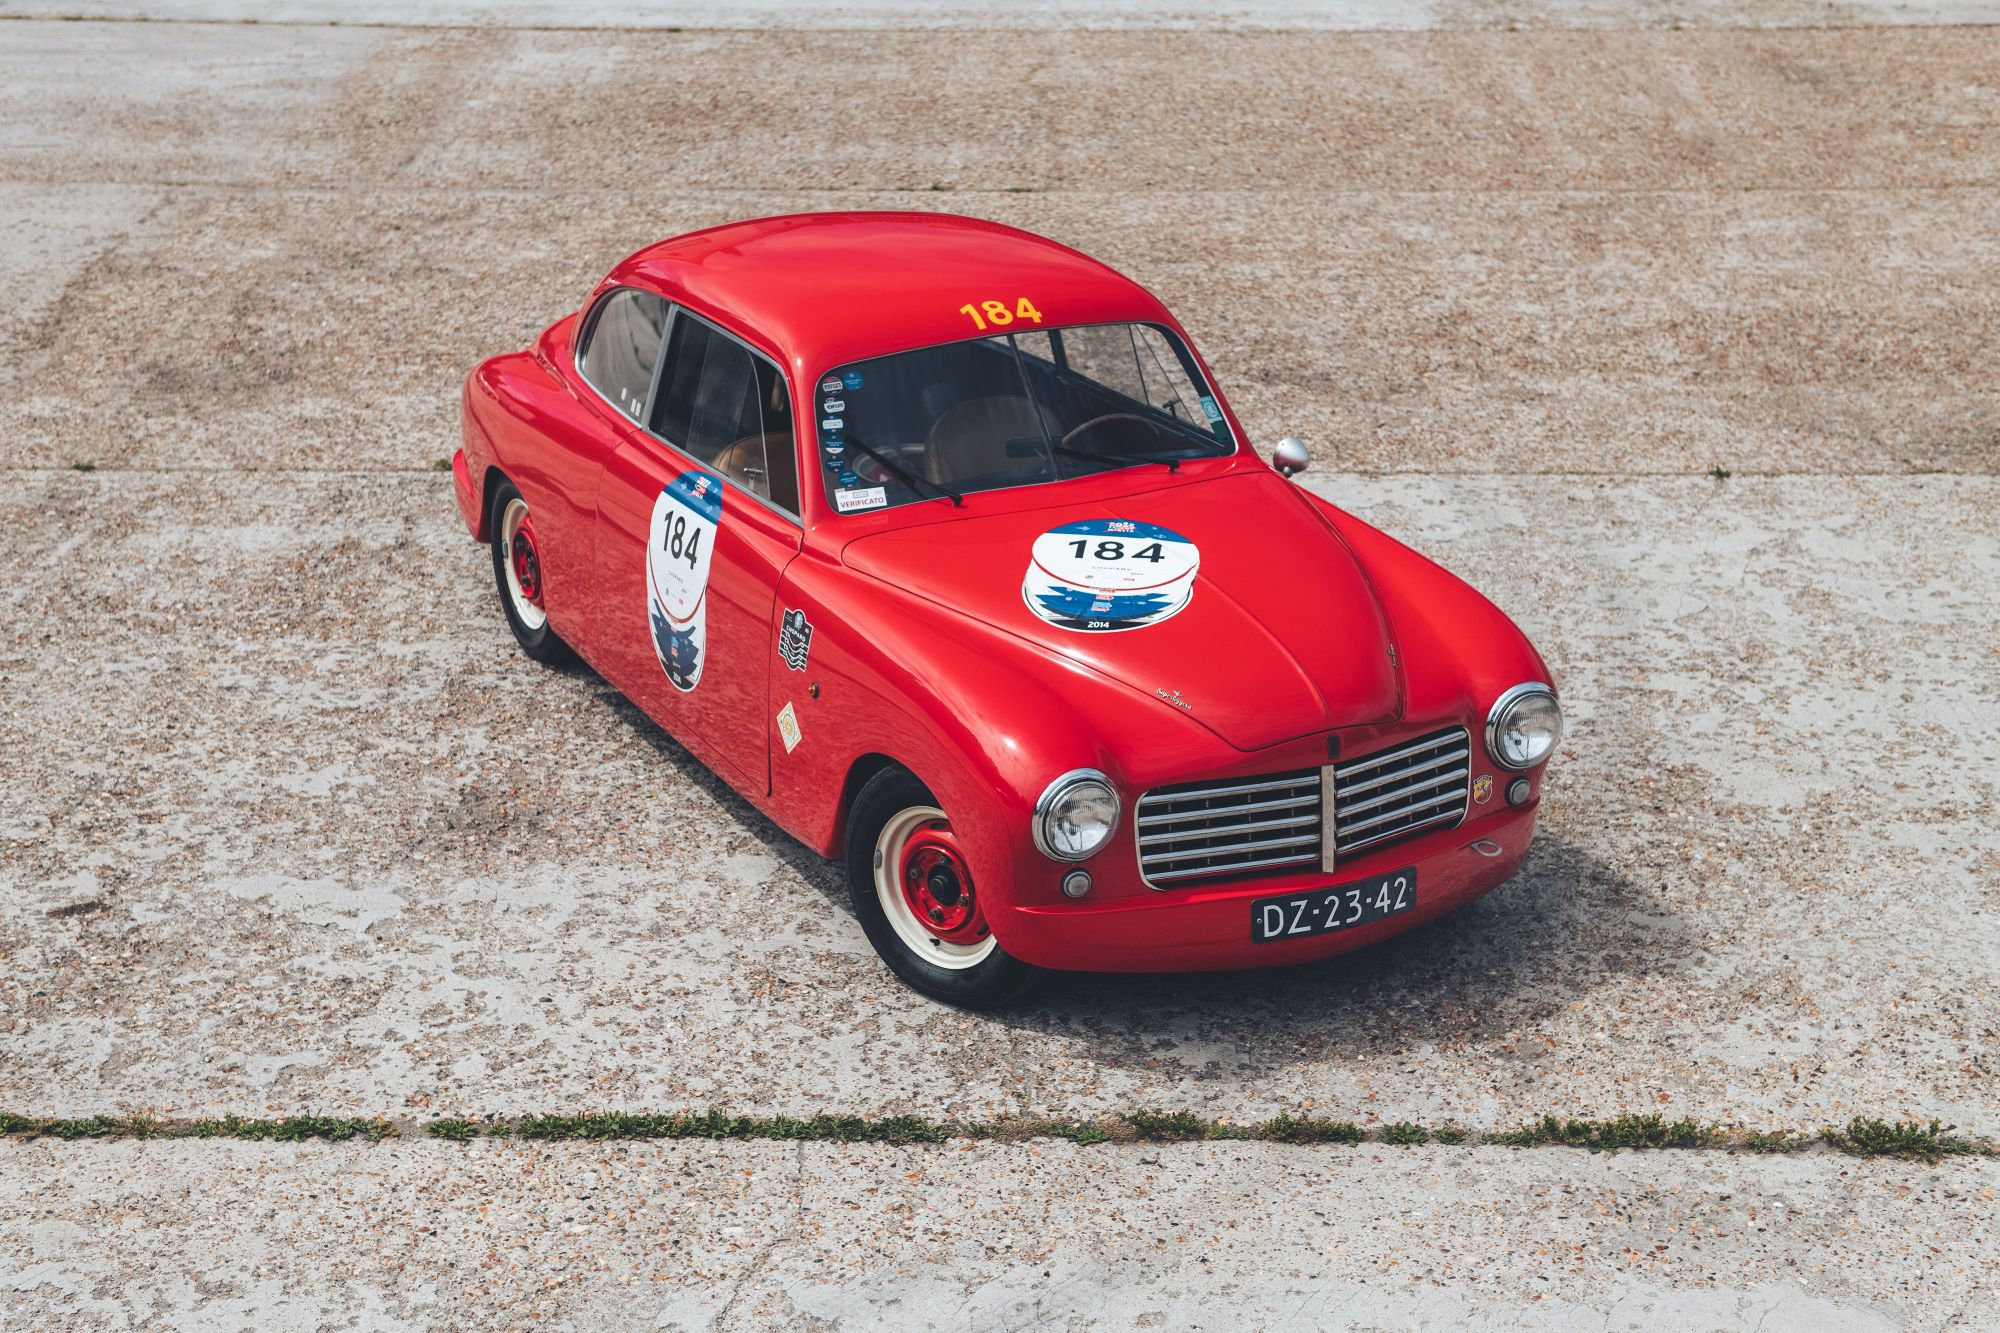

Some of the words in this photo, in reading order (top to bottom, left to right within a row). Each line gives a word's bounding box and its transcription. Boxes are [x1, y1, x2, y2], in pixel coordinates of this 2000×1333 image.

[959, 297, 1043, 330] 184
[840, 497, 884, 508] VERIFICATO
[663, 510, 702, 571] 184
[1068, 539, 1166, 563] 184
[786, 624, 806, 642] CHOPARD
